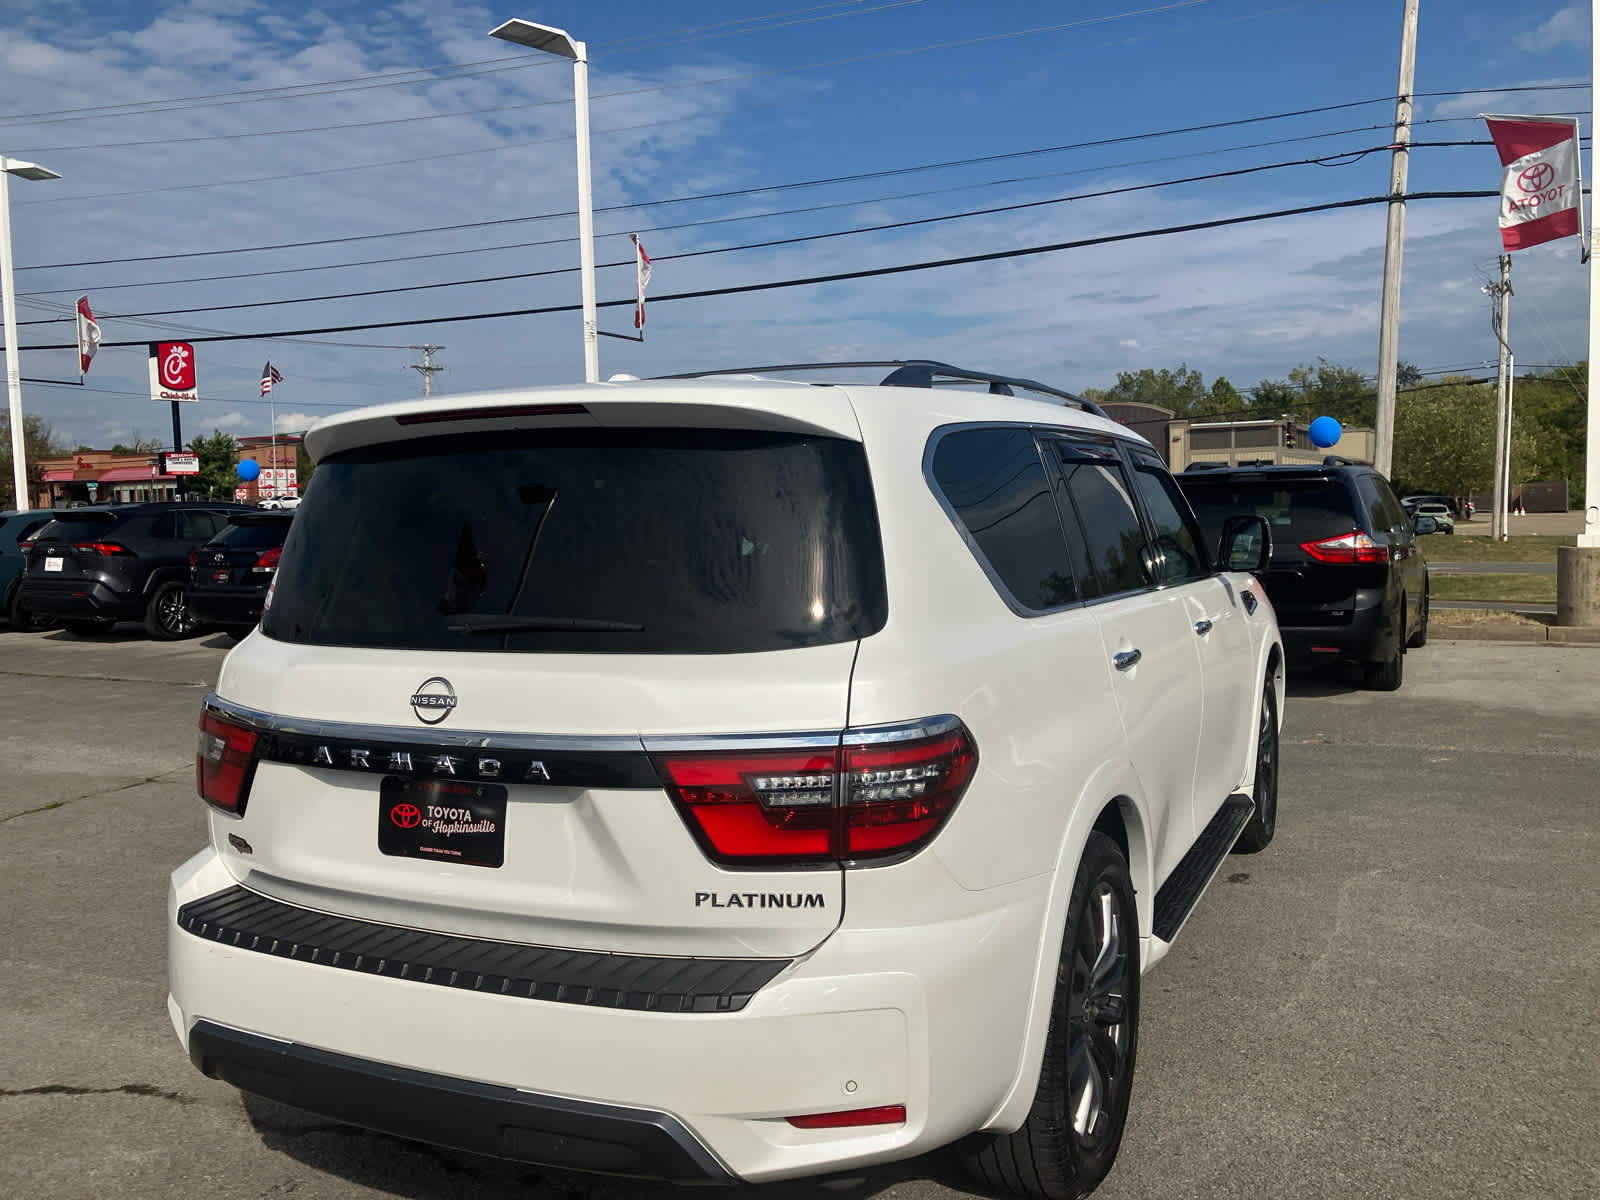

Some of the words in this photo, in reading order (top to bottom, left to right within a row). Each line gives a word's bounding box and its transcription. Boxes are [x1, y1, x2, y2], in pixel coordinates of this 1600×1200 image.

[411, 695, 455, 706] NISSAN
[314, 746, 550, 780] ARMADA
[427, 805, 472, 822] TOYOTA
[422, 819, 432, 827] OF
[432, 820, 496, 837] Hopkinsville
[695, 892, 825, 908] PLATINUM
